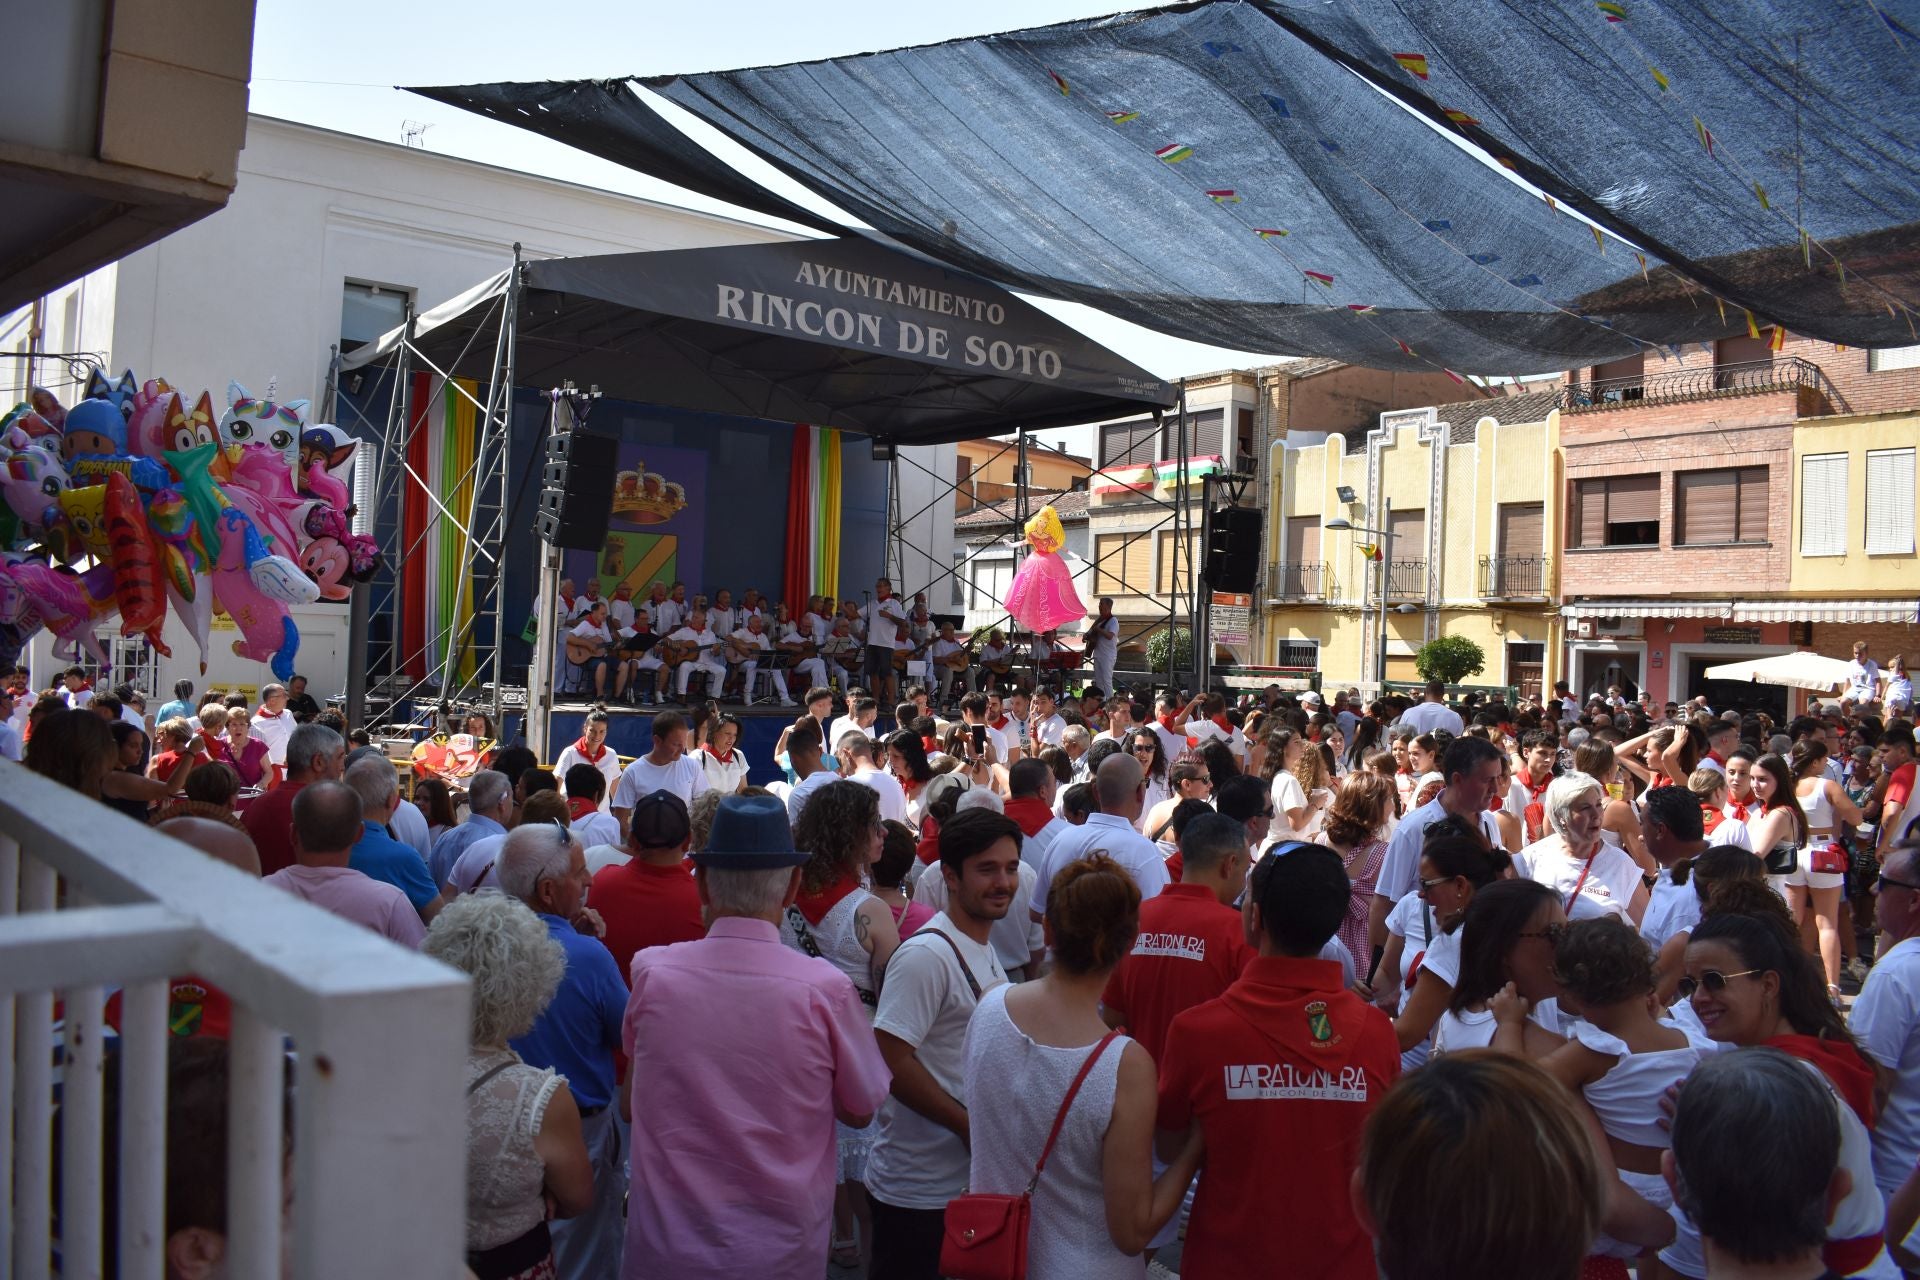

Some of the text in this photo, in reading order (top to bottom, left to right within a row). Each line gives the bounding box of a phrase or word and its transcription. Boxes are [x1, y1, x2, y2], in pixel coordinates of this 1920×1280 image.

[795, 261, 1005, 325] AYUNTAMIENTO
[716, 284, 1062, 379] RINCON DE SOTO
[1227, 1065, 1254, 1089] LA
[1259, 1089, 1365, 1100] RINCON DE SOTO
